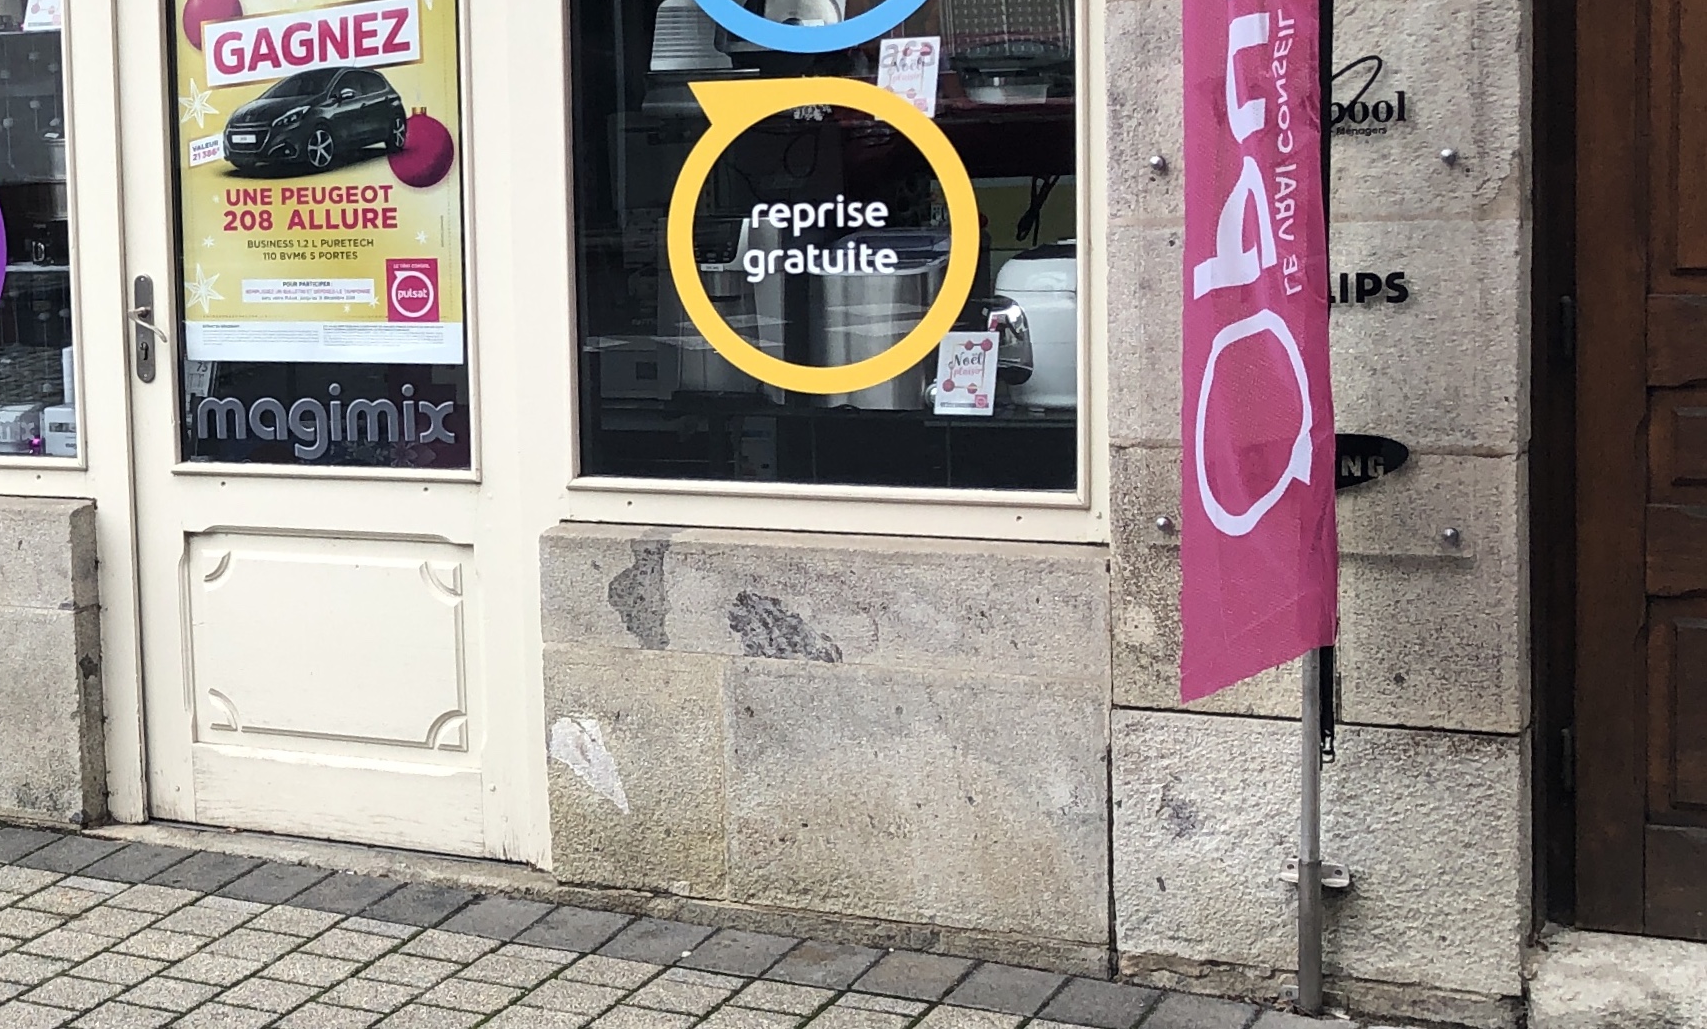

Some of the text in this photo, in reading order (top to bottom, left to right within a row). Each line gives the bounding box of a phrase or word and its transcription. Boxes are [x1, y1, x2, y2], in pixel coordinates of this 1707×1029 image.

[212, 7, 411, 75] GAGNEZ
[192, 140, 219, 152] VALEUR
[226, 184, 394, 207] UNE PEUGEOT
[223, 207, 398, 232] 208 ALLURE
[751, 193, 889, 237] reprise
[247, 239, 294, 249] BUSINESS
[312, 239, 318, 248] L
[320, 238, 374, 248] PURETECH
[263, 251, 358, 261] 110 BVM6 5 PORTES
[743, 242, 899, 283] gratuite
[397, 288, 428, 300] pulsat
[197, 382, 456, 460] magimix
